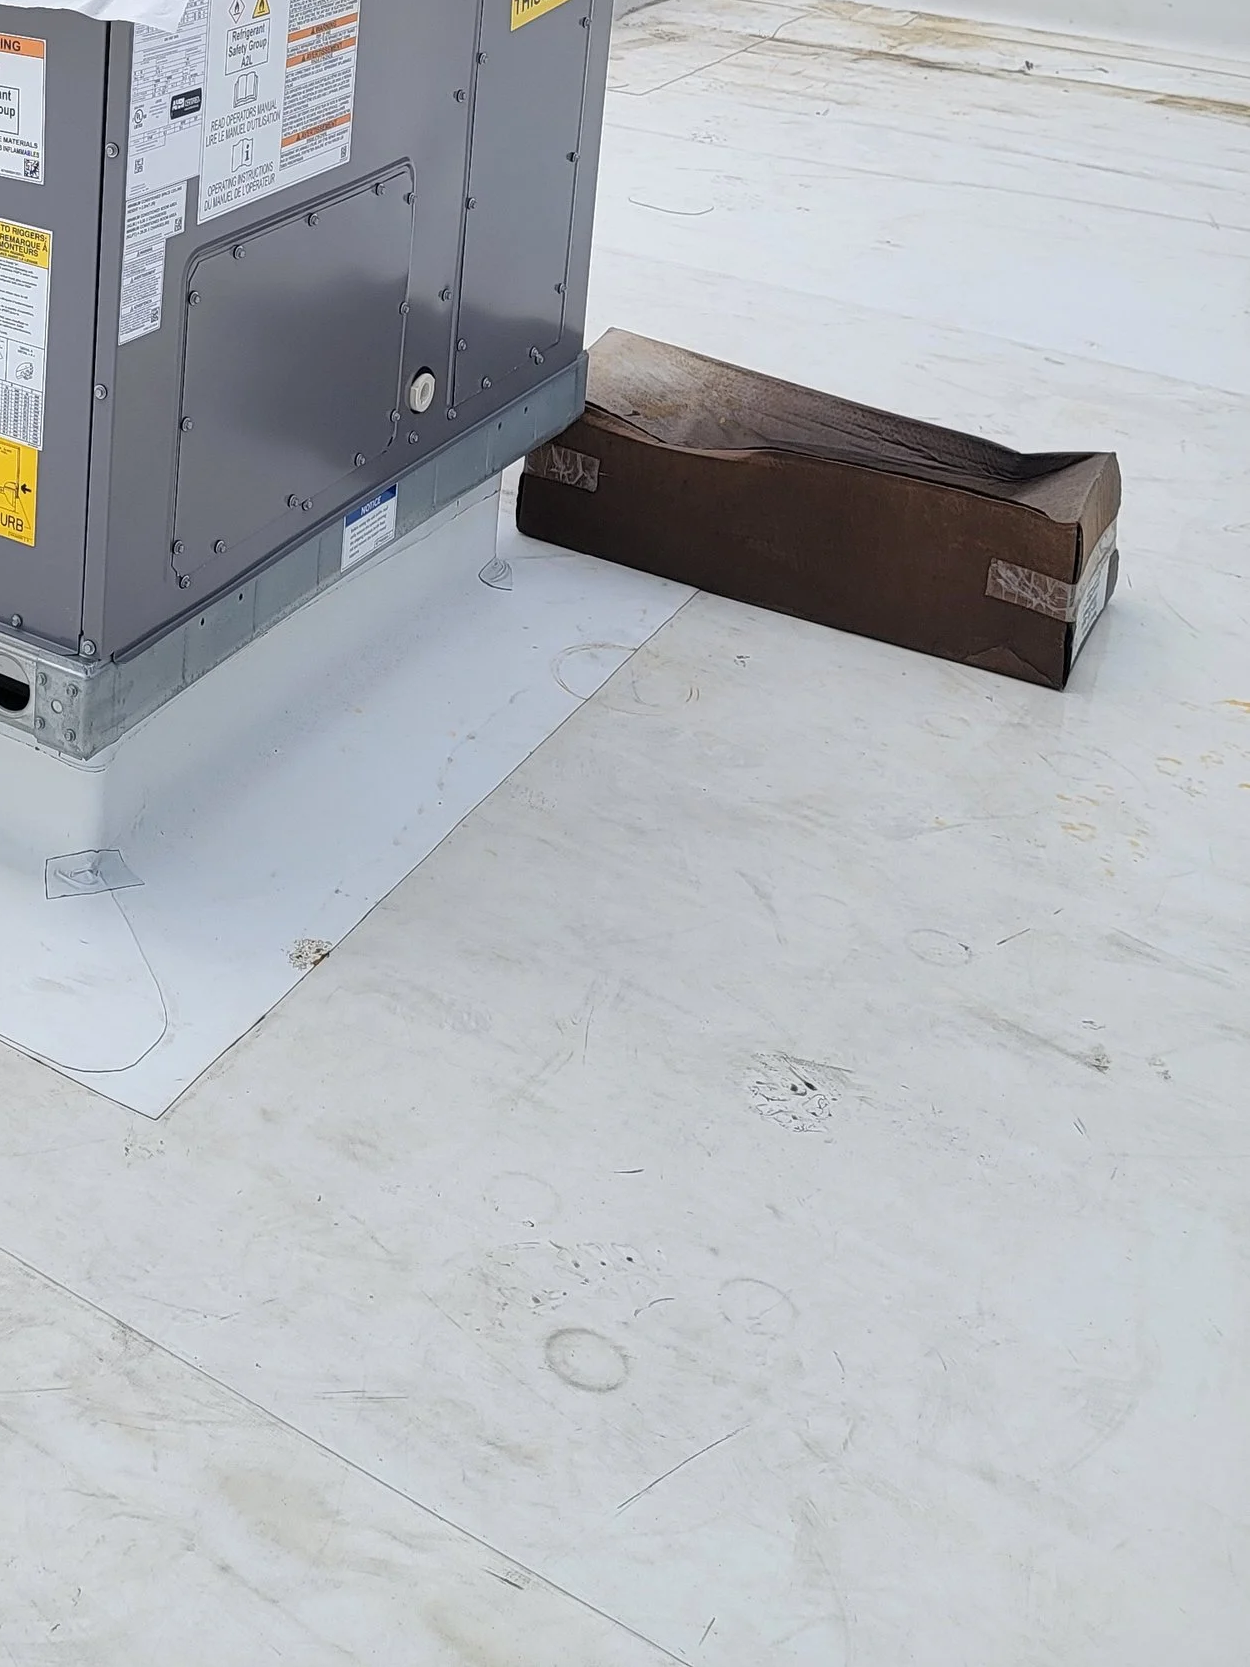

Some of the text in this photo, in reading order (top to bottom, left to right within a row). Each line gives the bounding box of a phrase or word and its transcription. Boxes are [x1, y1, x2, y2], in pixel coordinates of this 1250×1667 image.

[231, 24, 266, 42] Refrigerant
[228, 37, 268, 58] Safety Group
[240, 56, 253, 68] A2L
[211, 101, 277, 132] READ OPERATORS MANUAL
[3, 136, 38, 149] MATERIALS
[205, 134, 218, 148] LIRE
[218, 131, 225, 142] LE
[225, 125, 247, 140] MANUEL
[3, 145, 40, 158] INFLAMMABLES
[207, 161, 274, 197] OPERATING INSTRUCTIONS
[204, 199, 213, 212] DU
[212, 190, 234, 207] MANUEL
[233, 187, 242, 199] DE
[0, 224, 11, 233] TO
[12, 228, 47, 241] RIGGERS:
[0, 233, 41, 250] REMARQUE
[42, 241, 48, 253] À
[361, 495, 382, 516] NOTICE
